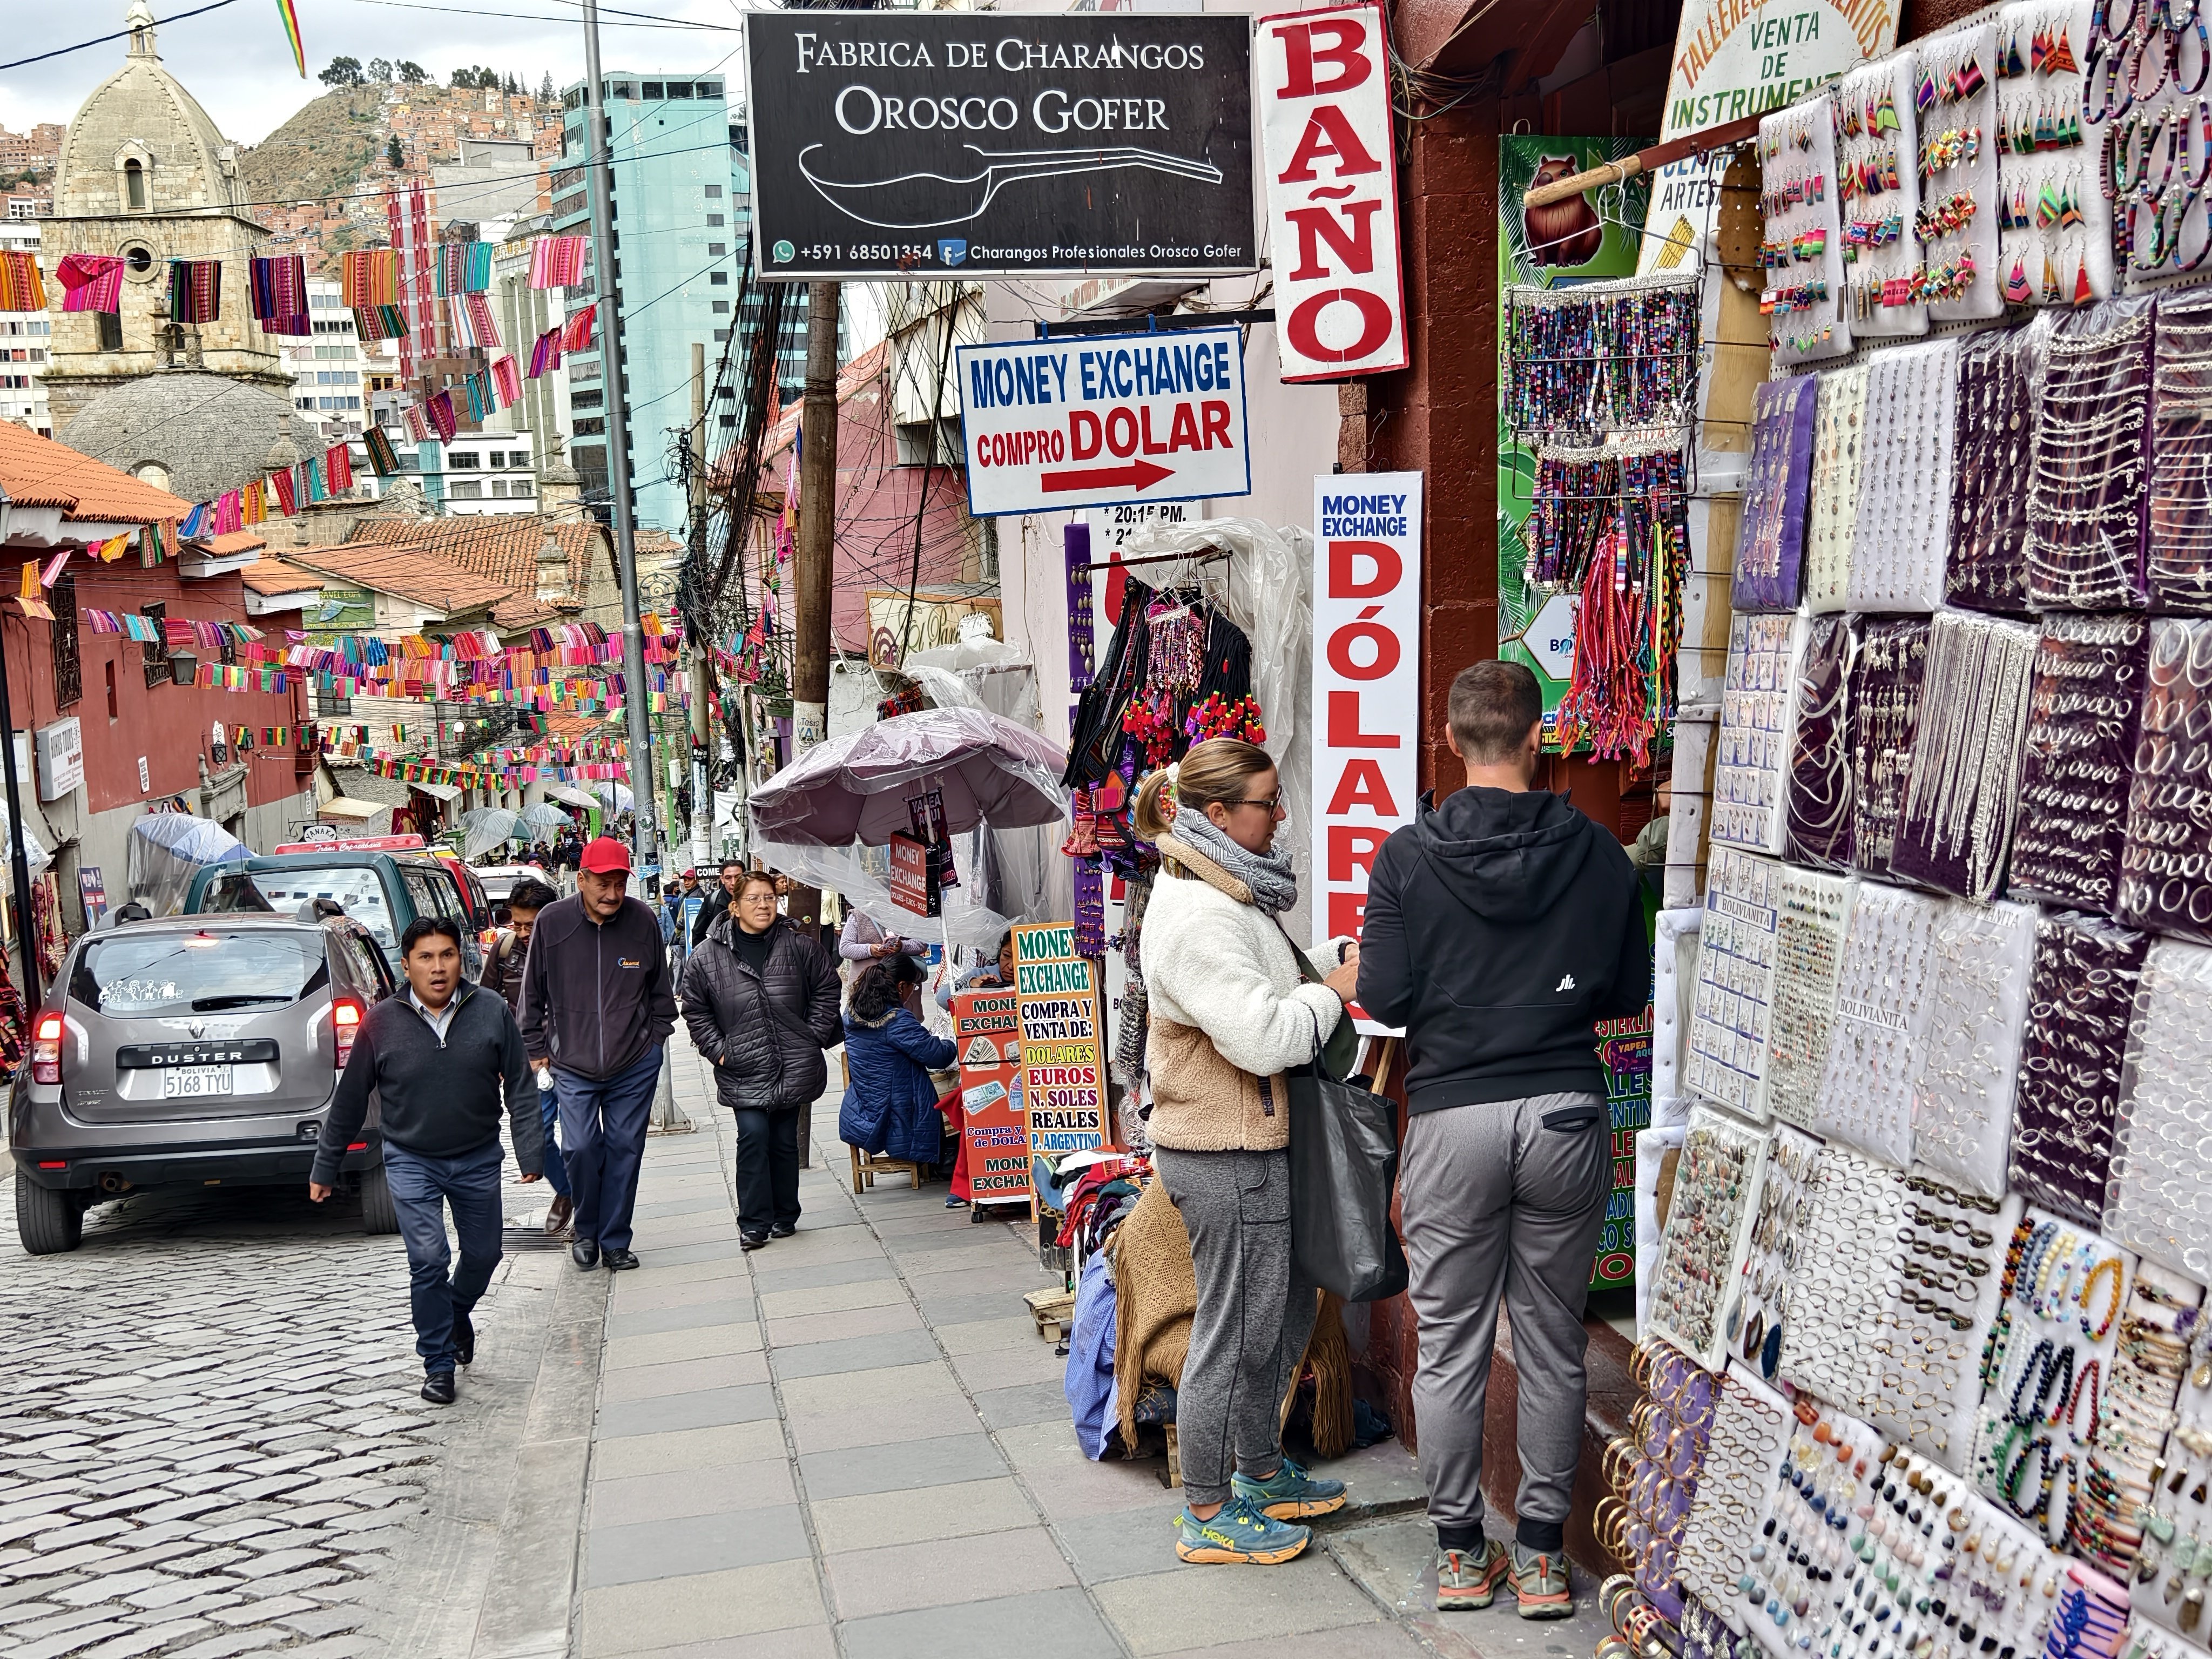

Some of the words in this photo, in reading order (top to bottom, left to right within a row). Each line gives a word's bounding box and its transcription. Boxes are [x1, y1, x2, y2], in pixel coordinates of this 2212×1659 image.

[1751, 11, 1819, 51] VENTA
[1761, 52, 1788, 80] DE
[1272, 19, 1392, 362] BAÑO
[801, 245, 840, 260] +591
[849, 244, 932, 260] 68501354
[970, 246, 1048, 262] Charangos
[1053, 245, 1145, 259] Profesionales
[1150, 245, 1199, 258] Orosco
[1204, 245, 1242, 258] Gofer
[970, 354, 1068, 409] MONEY
[1080, 342, 1231, 401] EXCHANGE
[977, 429, 1064, 468] COMPRO
[1069, 400, 1233, 461] DOLAR
[1161, 505, 1186, 523] PM.
[1323, 494, 1407, 515] MONEY
[1323, 516, 1407, 537] EXCHANGE
[306, 828, 335, 840] YANAKA
[895, 843, 919, 866] MONEY
[891, 865, 926, 893] EXCHANGE
[1722, 897, 1770, 926] BOLIVIANITA
[1019, 962, 1089, 994] EXCHANGE
[973, 999, 1017, 1013] MONE
[1021, 1001, 1080, 1020] COMPRA
[1082, 1000, 1092, 1017] Y
[1839, 998, 1908, 1030] BOLIVIANITA
[1024, 1021, 1068, 1040] VENTA
[1069, 1020, 1092, 1037] DE:
[1026, 1045, 1095, 1065] DOLARES
[1618, 1040, 1647, 1053] YAPEA
[1635, 1048, 1653, 1058] AQU
[152, 1051, 242, 1064] DUSTER
[166, 1075, 201, 1095] 5168
[205, 1073, 231, 1093] TYU
[1028, 1067, 1095, 1085] EUROS
[1030, 1091, 1044, 1107] N.
[1048, 1090, 1097, 1107] SOLES
[1031, 1111, 1099, 1128] REALES
[967, 1127, 1012, 1137] Compra
[1015, 1126, 1022, 1135] y
[1032, 1134, 1042, 1150] P.
[1044, 1133, 1101, 1150] ARGENTINO
[974, 1139, 988, 1148] de
[991, 1136, 1027, 1146] DOLA
[986, 1157, 1029, 1172] MONE
[1201, 1527, 1235, 1552] HOKA
